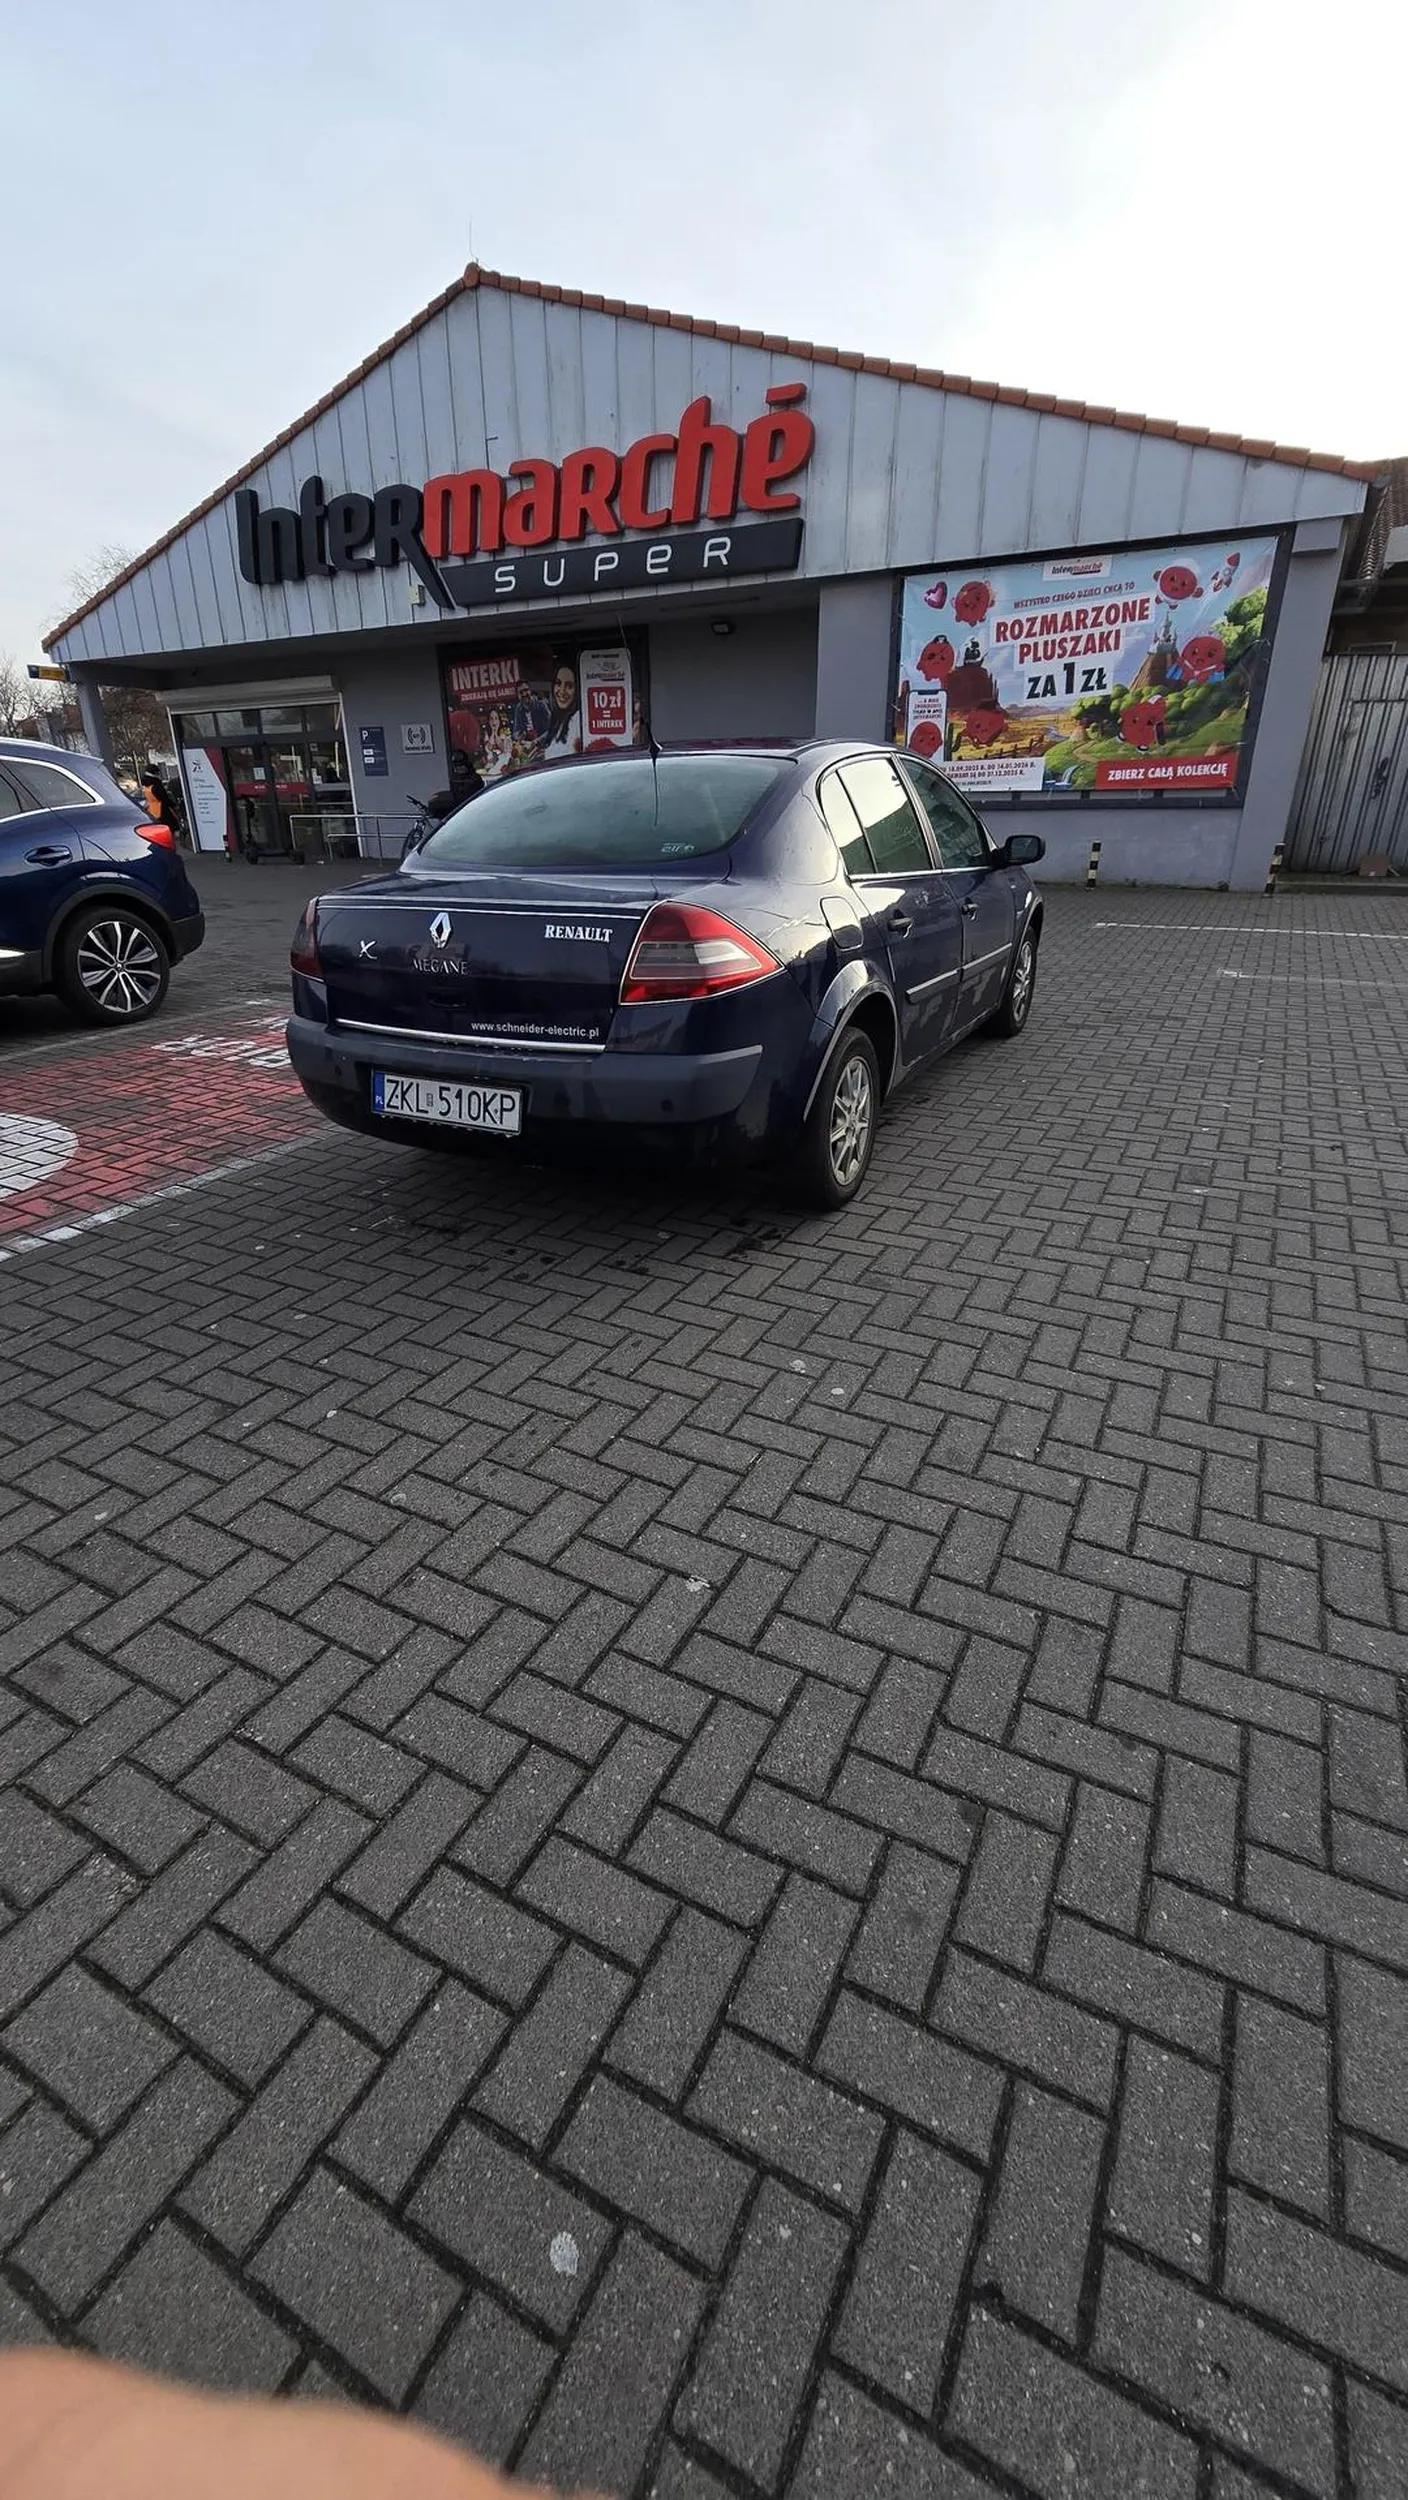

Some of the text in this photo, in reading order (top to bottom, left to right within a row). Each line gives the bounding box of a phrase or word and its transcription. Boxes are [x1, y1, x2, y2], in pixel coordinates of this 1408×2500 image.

[494, 536, 732, 593] SUPER
[1013, 596, 1050, 609] WSZYSTKO
[1052, 591, 1075, 603] CZEGO
[1077, 586, 1101, 599] DZIECI
[1125, 581, 1135, 591] TO
[996, 597, 1150, 643] ROZMARZONE
[1019, 629, 1121, 665] PLUSZAKI
[452, 660, 519, 691] INTERKI
[1026, 662, 1107, 700] ZA 1 ZŁ
[593, 690, 622, 708] 10 zł
[1108, 763, 1228, 780] ZBIERZ CAŁĄ KOLEKCJĘ
[544, 924, 613, 943] RENAULT
[471, 1020, 600, 1039] www.schneider-electric.pl
[386, 1078, 516, 1125] ZKL 510KP
